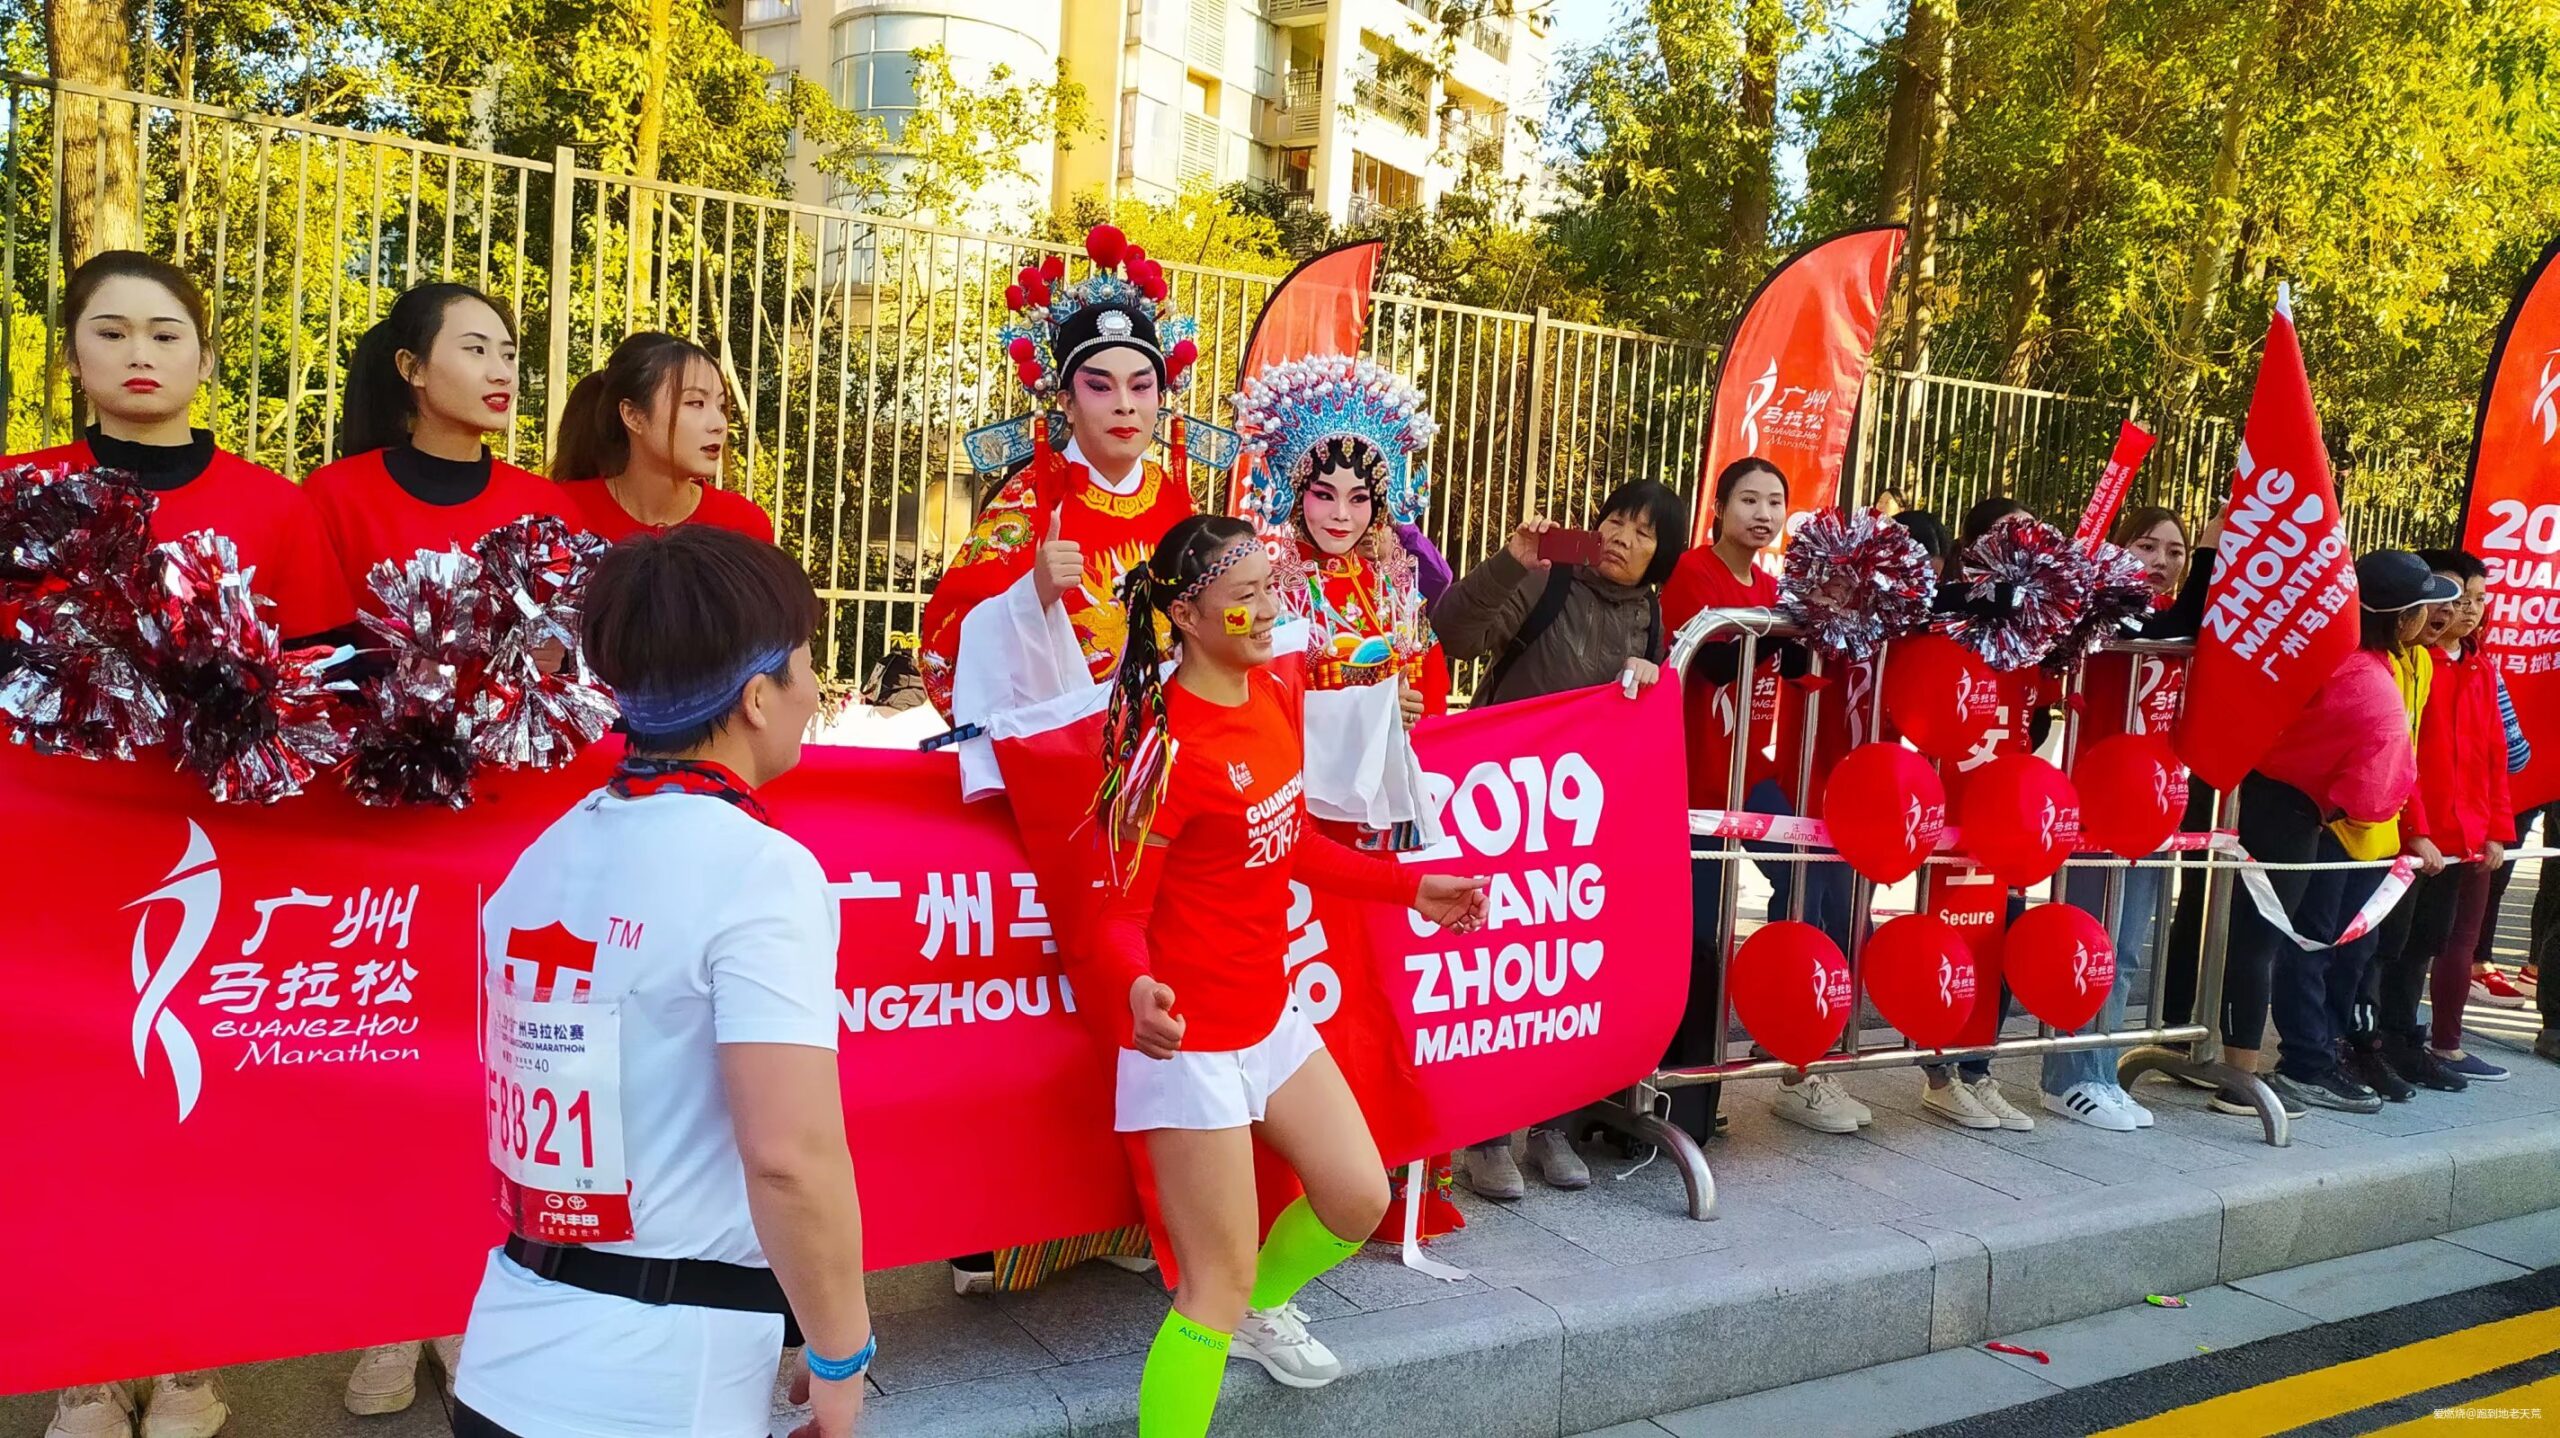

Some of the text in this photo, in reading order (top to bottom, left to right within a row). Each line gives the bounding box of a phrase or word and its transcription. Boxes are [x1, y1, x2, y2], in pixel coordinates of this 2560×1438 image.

[1777, 387, 1831, 412] 广州
[1762, 406, 1825, 430] 马拉松
[1762, 426, 1822, 441] GUANGZHOU
[1765, 436, 1820, 451] Marathon
[2201, 519, 2307, 643] ZHOU
[2232, 518, 2347, 661] MARATHON
[1246, 769, 1304, 824] GUANGZH
[1396, 753, 1604, 864] 2019
[1248, 802, 1296, 839] MARATHON
[1722, 826, 1759, 838] SAFE
[1245, 819, 1293, 868] 2019
[1783, 832, 1819, 843] CAUTION
[242, 885, 420, 955] 广州
[1940, 909, 1995, 925] Secure
[607, 916, 644, 951] TM
[199, 957, 419, 1014] 马拉松
[1405, 938, 1568, 1014] ZHOU
[211, 1015, 419, 1039] GUANGZHOU
[1415, 1002, 1601, 1066] MARATHON
[235, 1039, 420, 1071] Marathon
[536, 1042, 585, 1053] MARATHON
[534, 1059, 549, 1073] 40
[540, 1212, 599, 1226] 广汽丰田
